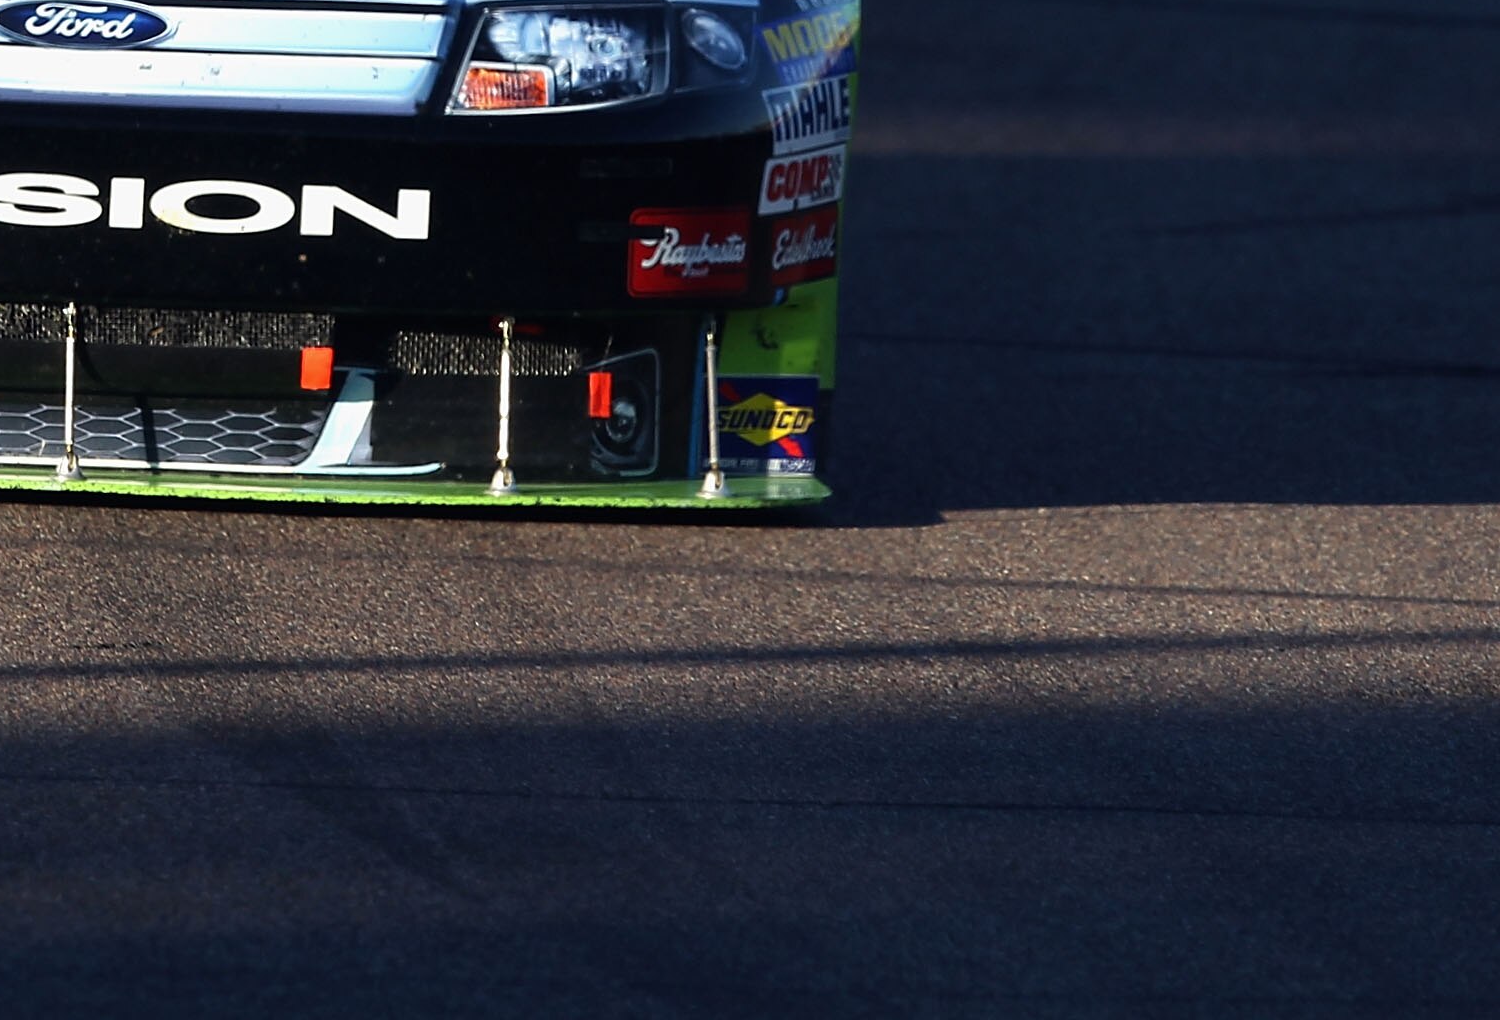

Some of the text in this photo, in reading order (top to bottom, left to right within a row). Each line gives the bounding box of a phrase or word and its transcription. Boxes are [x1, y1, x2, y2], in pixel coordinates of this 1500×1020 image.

[24, 2, 137, 41] Ford
[767, 78, 849, 143] MAHLE
[767, 155, 830, 203] COMP
[716, 409, 809, 430] SUNOCO
